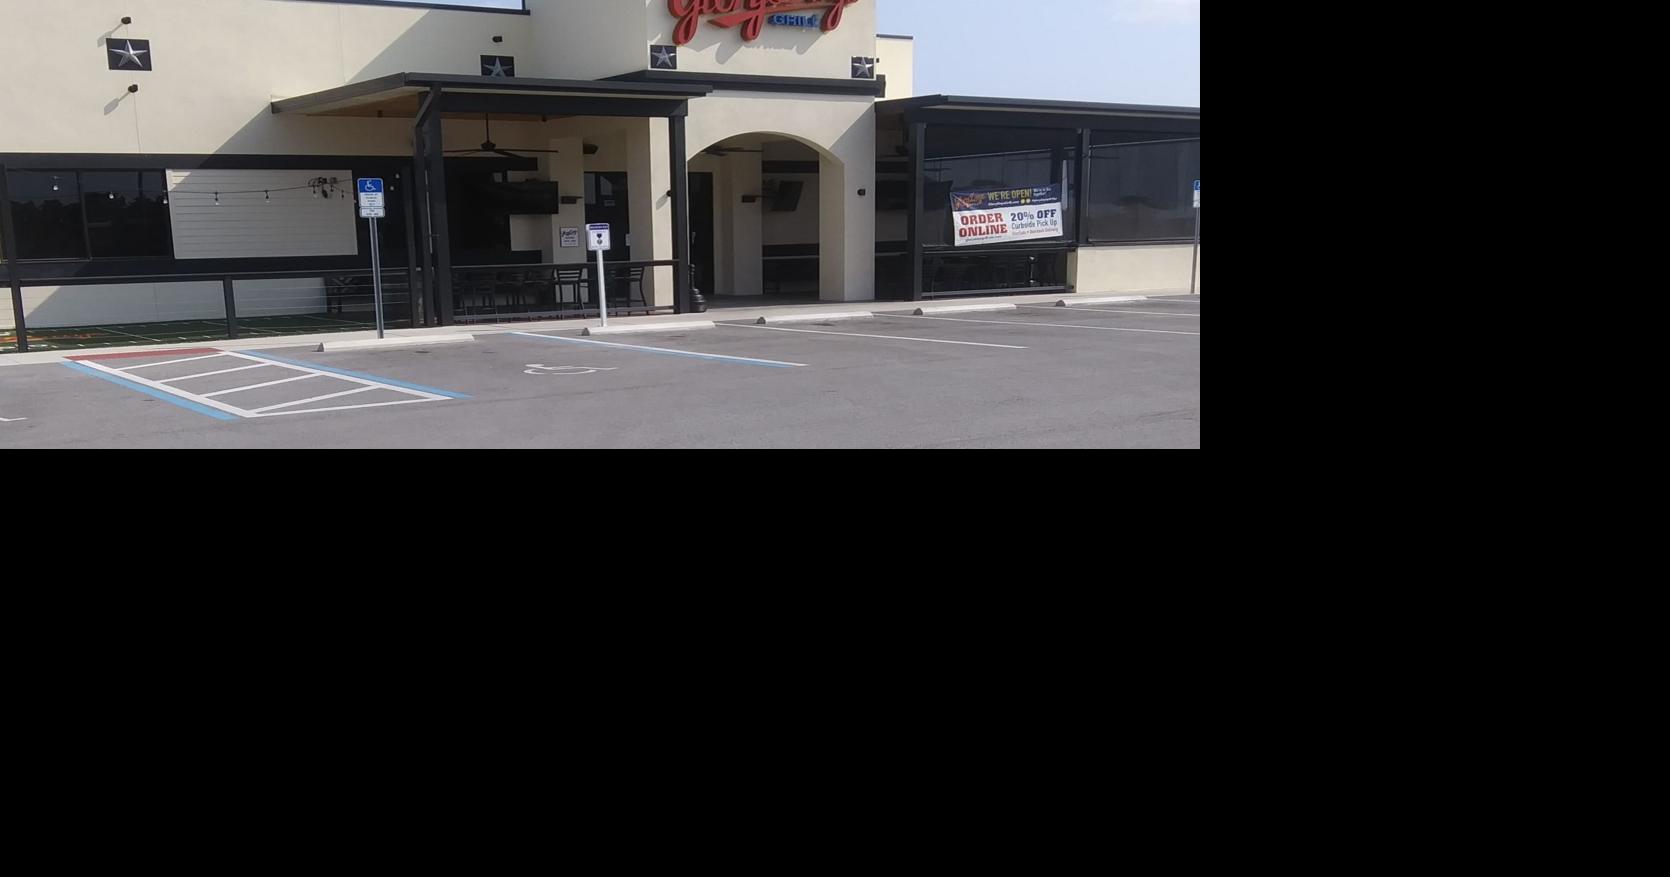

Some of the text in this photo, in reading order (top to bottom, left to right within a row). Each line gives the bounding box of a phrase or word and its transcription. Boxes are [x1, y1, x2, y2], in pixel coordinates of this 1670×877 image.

[769, 14, 820, 28] GRILL
[1011, 188, 1032, 199] OPEN!
[961, 213, 1003, 225] ORDER
[1010, 208, 1057, 221] 20% OFF
[1011, 218, 1058, 230] Curbside Pick Up
[959, 224, 1008, 237] ONLINE
